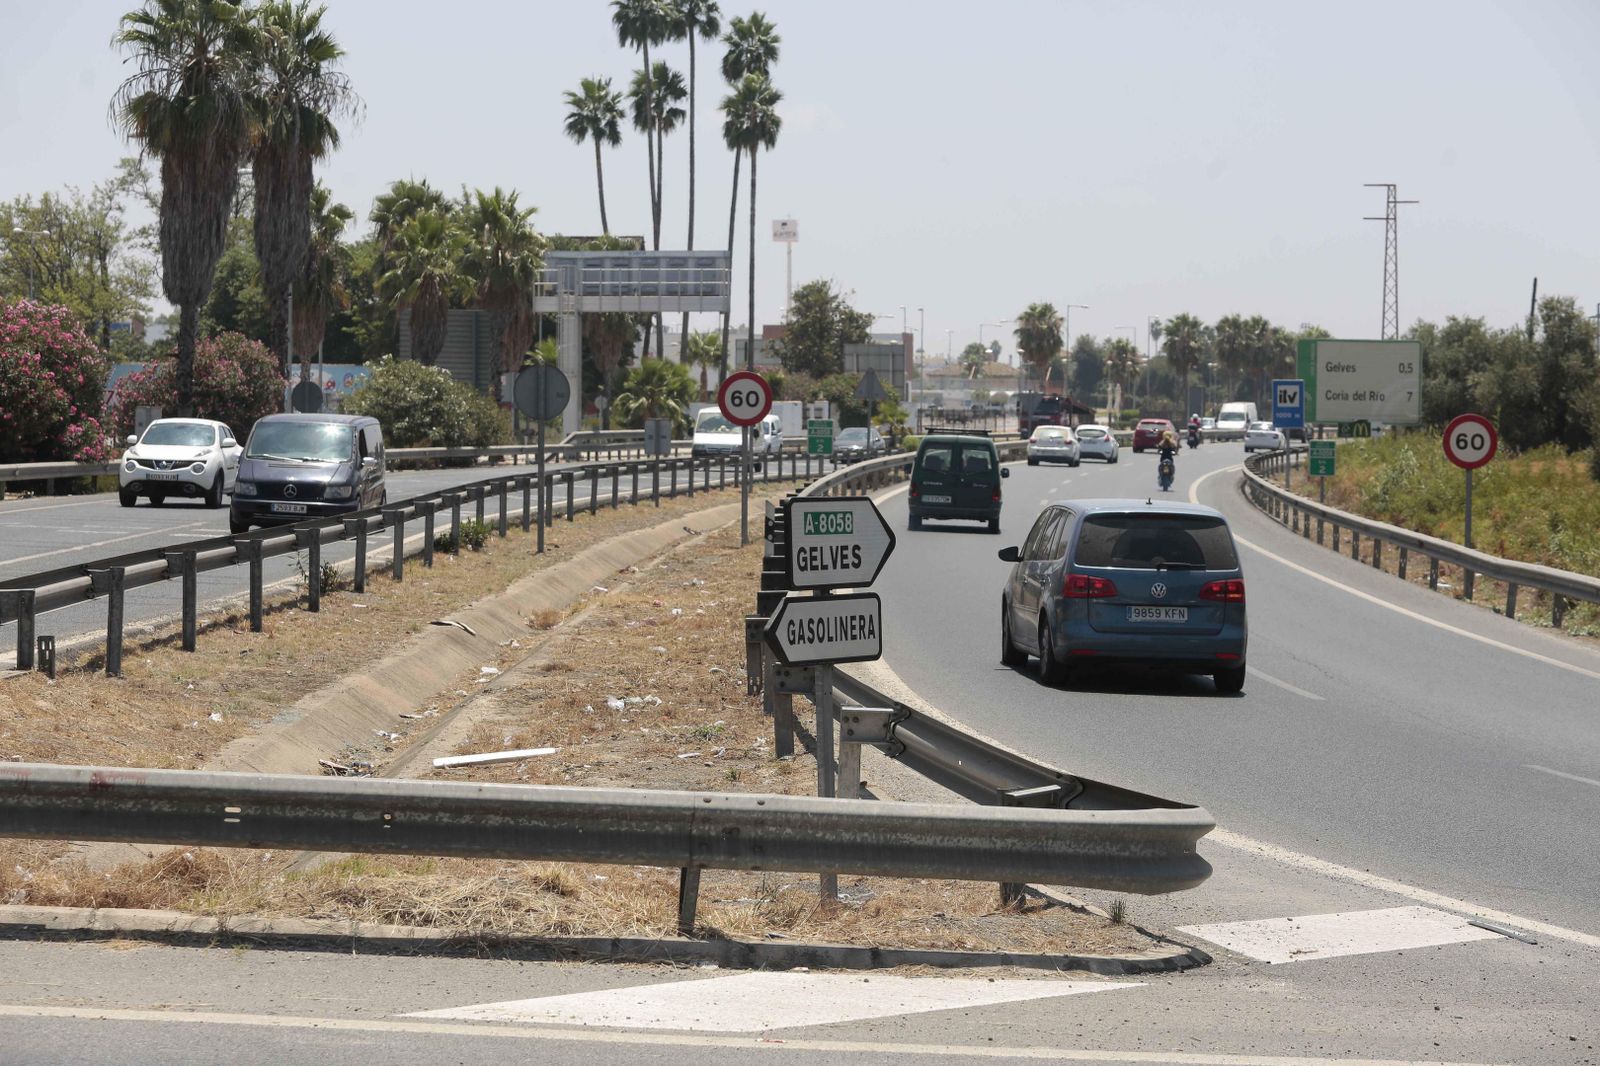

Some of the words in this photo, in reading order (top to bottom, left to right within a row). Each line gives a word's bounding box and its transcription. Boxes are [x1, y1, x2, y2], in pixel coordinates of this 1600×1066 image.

[1325, 361, 1357, 373] Gelves
[730, 390, 760, 408] 60
[1325, 390, 1349, 401] Coria
[1352, 390, 1366, 401] del
[1407, 392, 1413, 402] 7
[816, 444, 824, 452] 2
[1455, 433, 1485, 451] 60
[1319, 465, 1327, 474] 2
[805, 513, 853, 533] A-8058
[797, 544, 862, 572] GELVES
[1134, 608, 1161, 618] 9859
[1164, 608, 1185, 619] KFN
[787, 614, 876, 646] GASOLINERA
